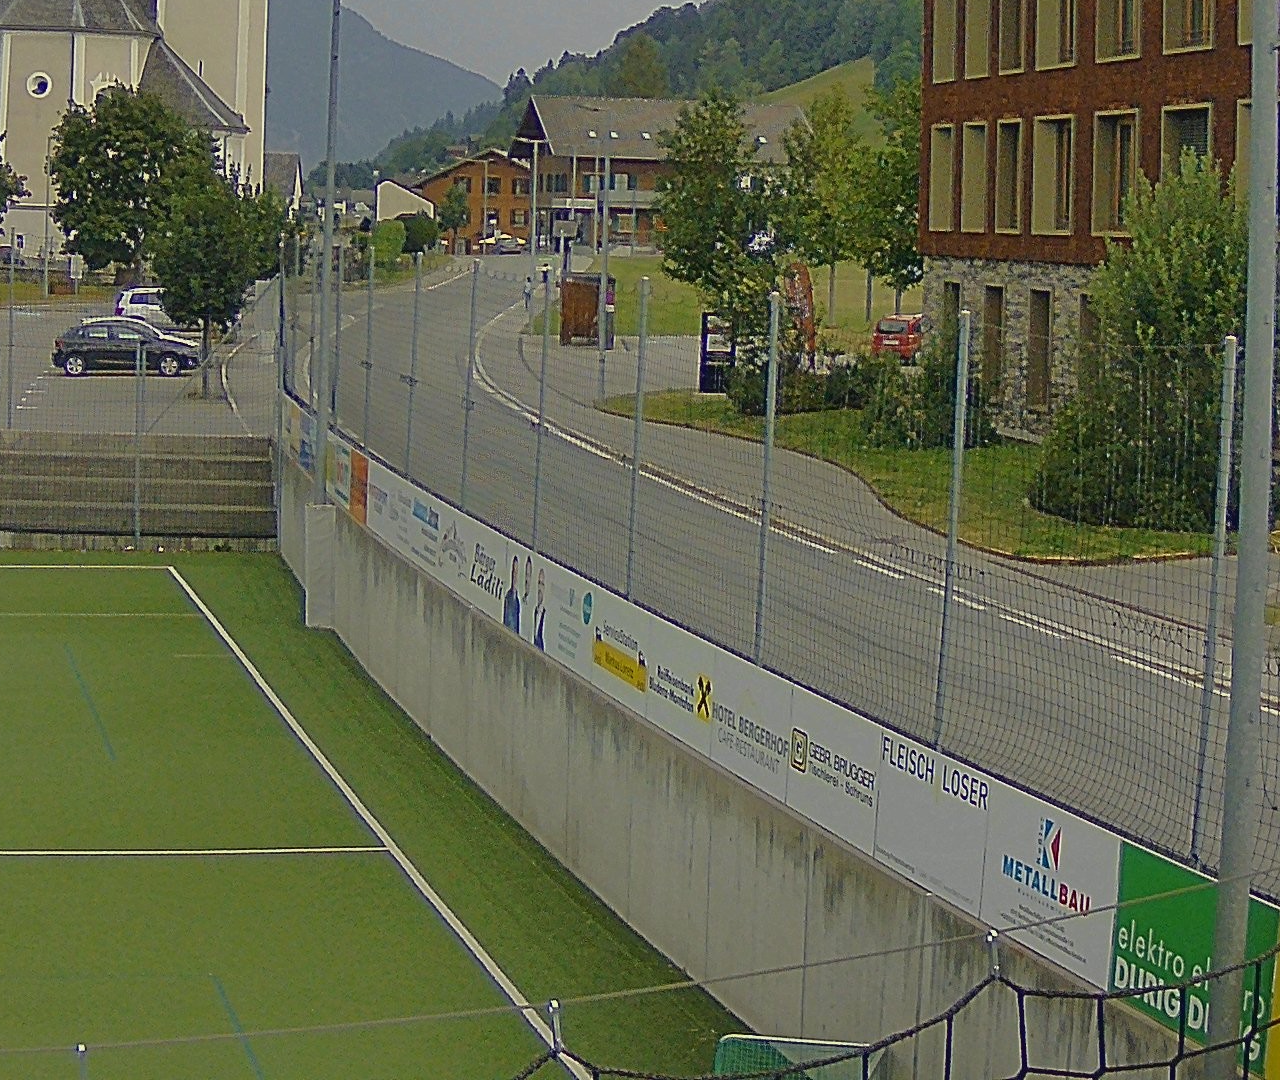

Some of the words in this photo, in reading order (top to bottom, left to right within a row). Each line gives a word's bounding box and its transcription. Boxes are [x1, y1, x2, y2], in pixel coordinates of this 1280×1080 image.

[712, 701, 737, 730] HOTEL
[738, 717, 790, 758] BERGERHOF
[883, 736, 935, 785] FLEISCH
[942, 765, 988, 811] LOSER
[1003, 854, 1090, 917] METALLBAU
[1118, 919, 1185, 978] elektro
